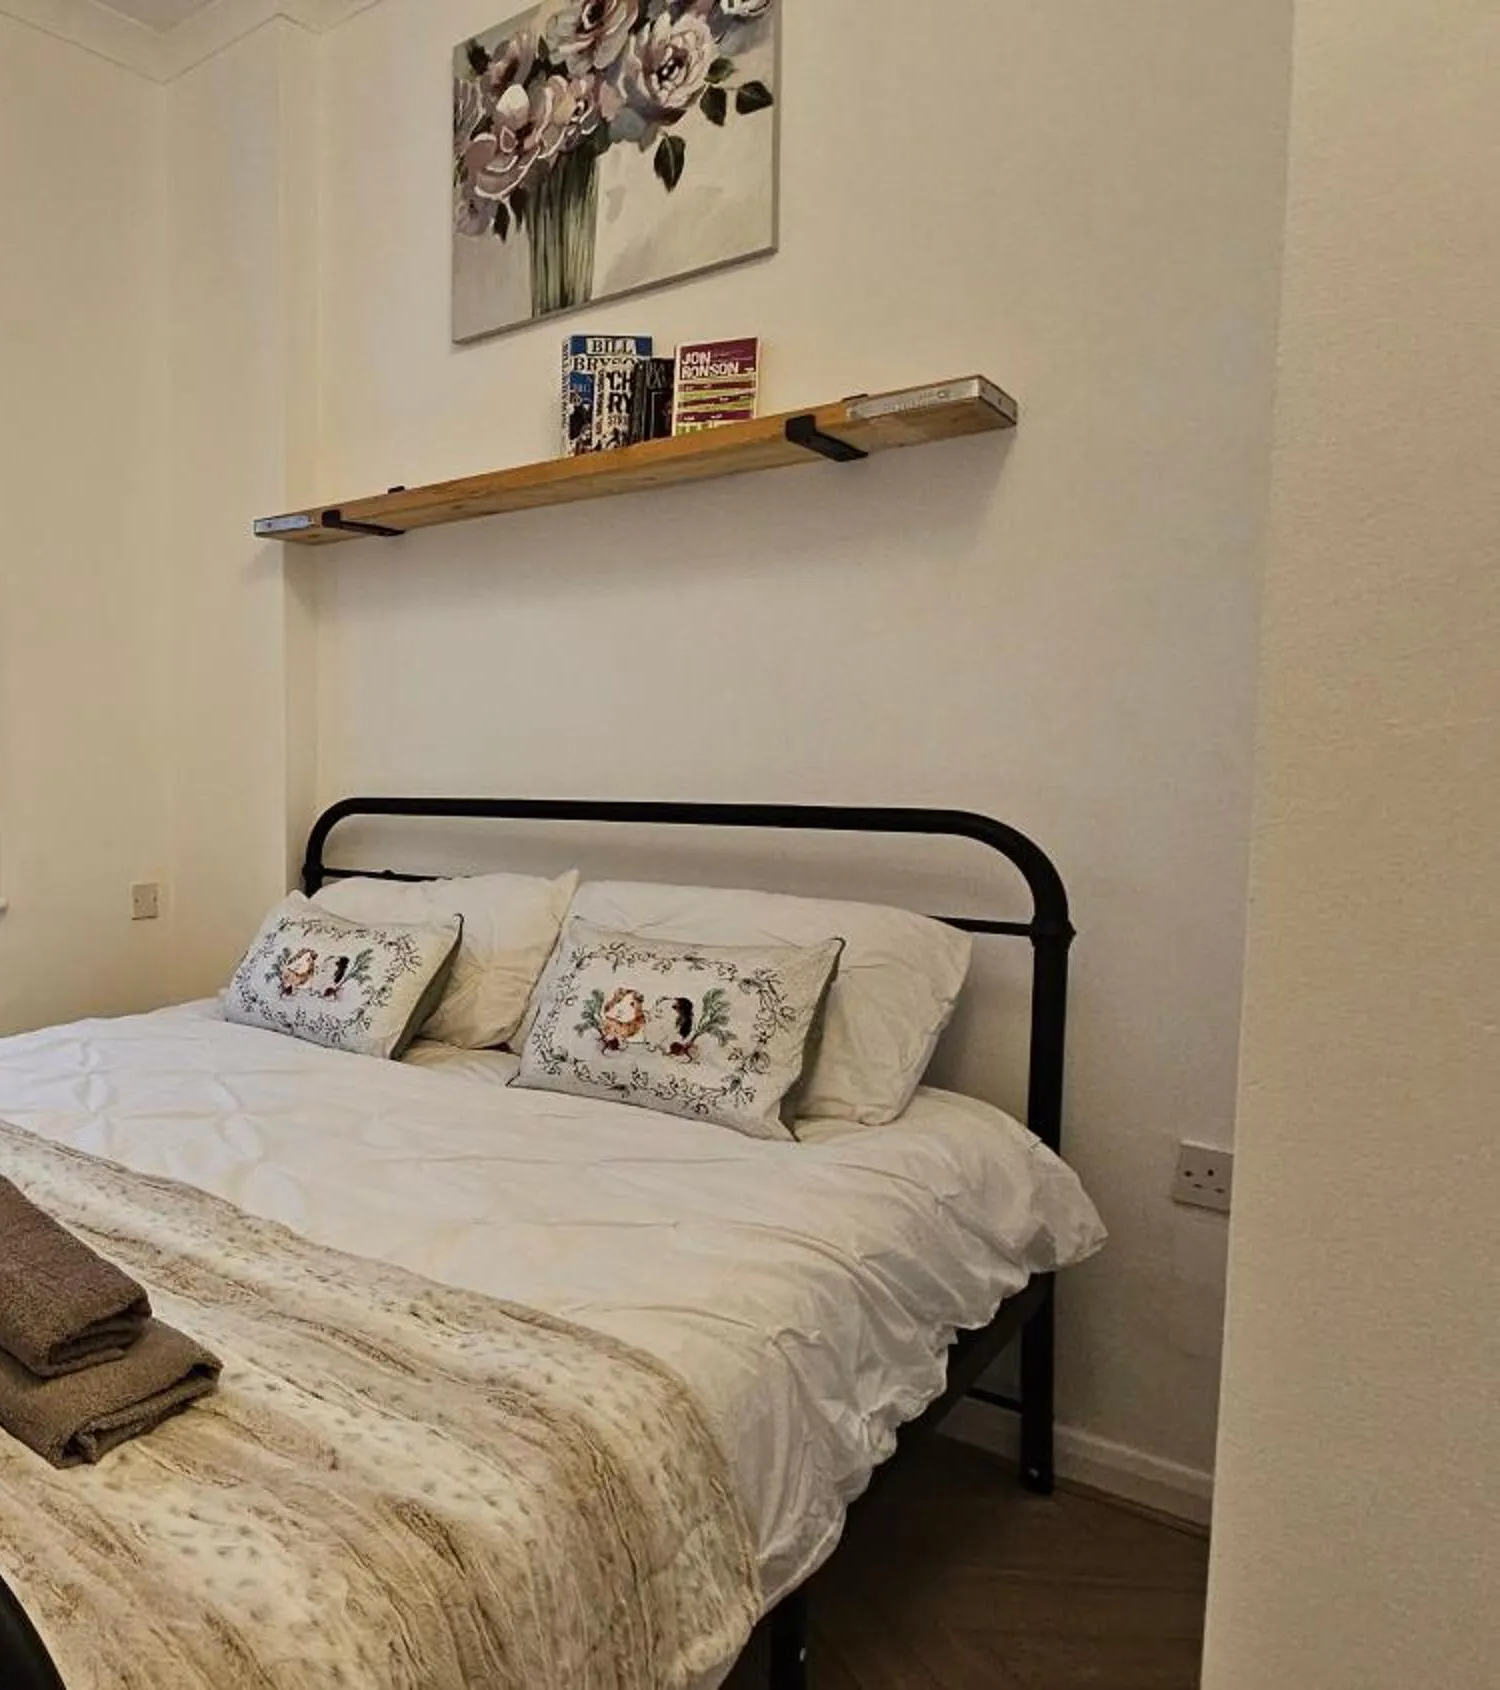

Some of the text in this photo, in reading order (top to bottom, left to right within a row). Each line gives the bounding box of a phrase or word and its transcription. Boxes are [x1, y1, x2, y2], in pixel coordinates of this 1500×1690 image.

[592, 339, 634, 354] BILL
[573, 357, 643, 371] BRYSO
[681, 351, 711, 366] JON
[681, 361, 739, 380] RONSON
